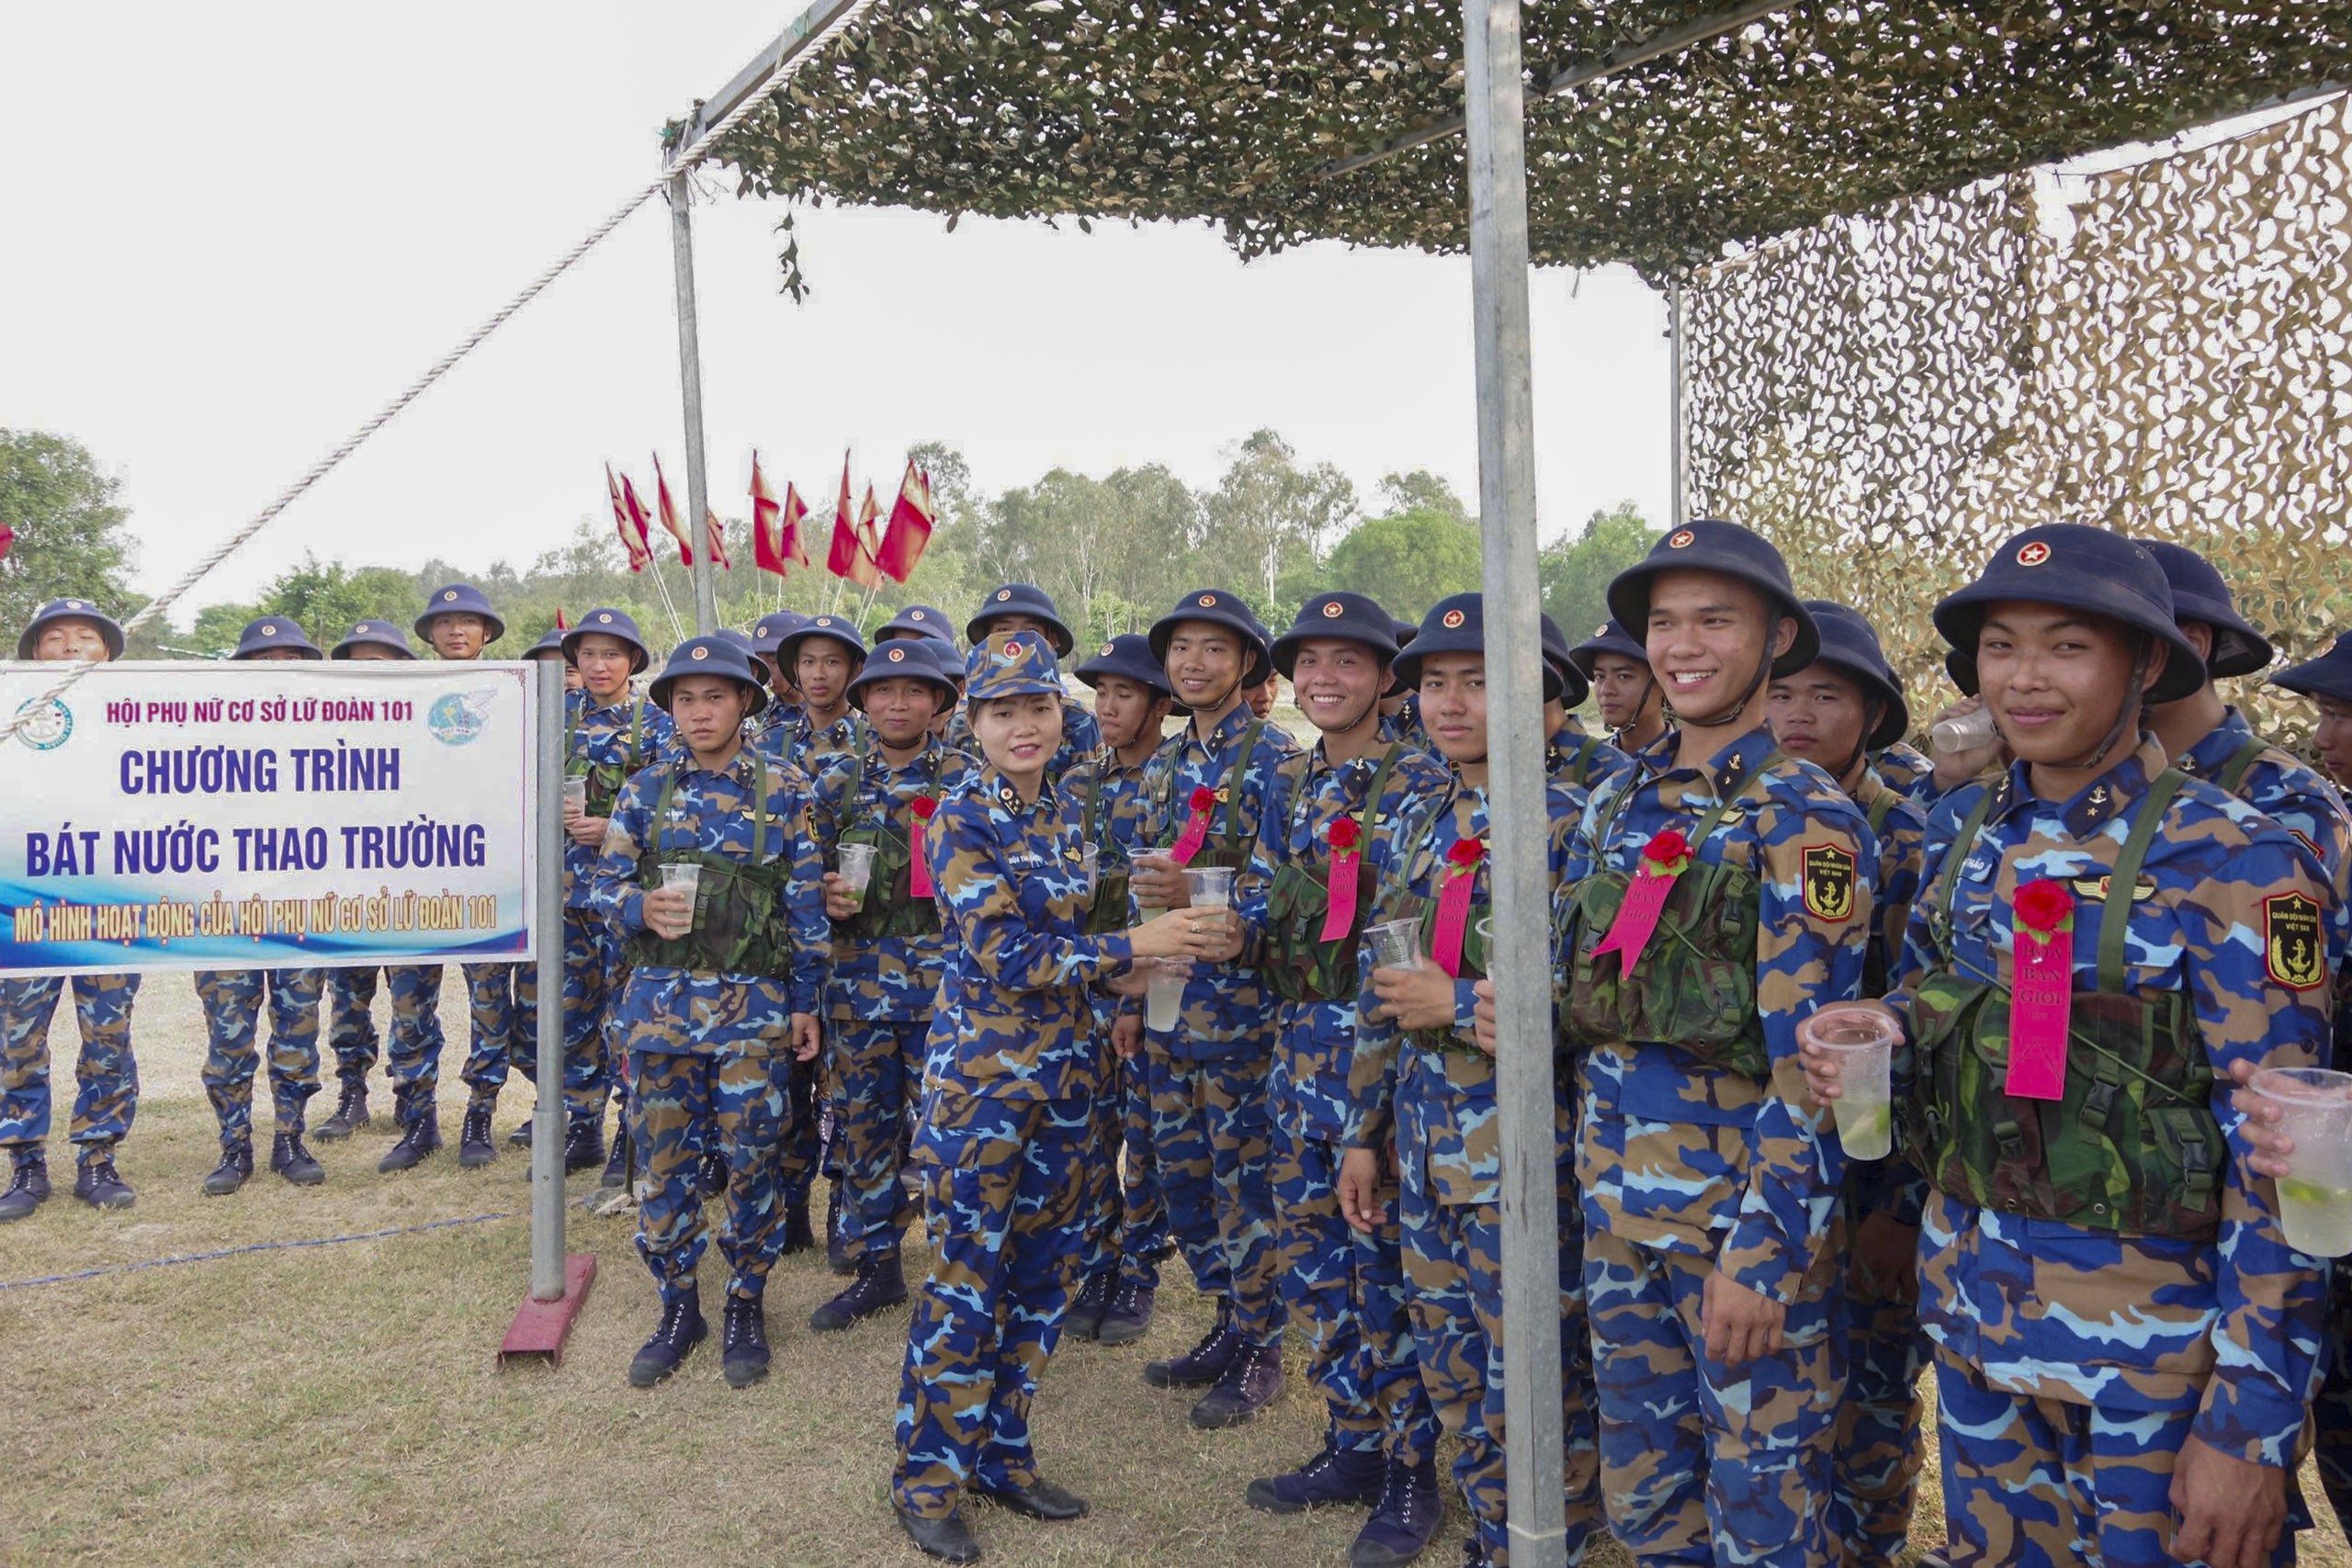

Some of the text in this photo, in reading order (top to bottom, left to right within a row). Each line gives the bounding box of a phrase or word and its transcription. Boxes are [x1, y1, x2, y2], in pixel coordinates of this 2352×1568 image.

[107, 694, 413, 728] HỘI PHỤ NỮ CƠ SỞ LỮ ĐOÀN 101
[119, 738, 400, 795] CHƯƠNG TRÌNH
[27, 814, 486, 877] BÁT NƯỚC THAO TRƯỜNG
[15, 886, 497, 946] MÔ HÌNH HOẠT ĐỘNG CỦA HỘI PHỤ NỮ CƠ SỞ LỮ ĐOÀN 101
